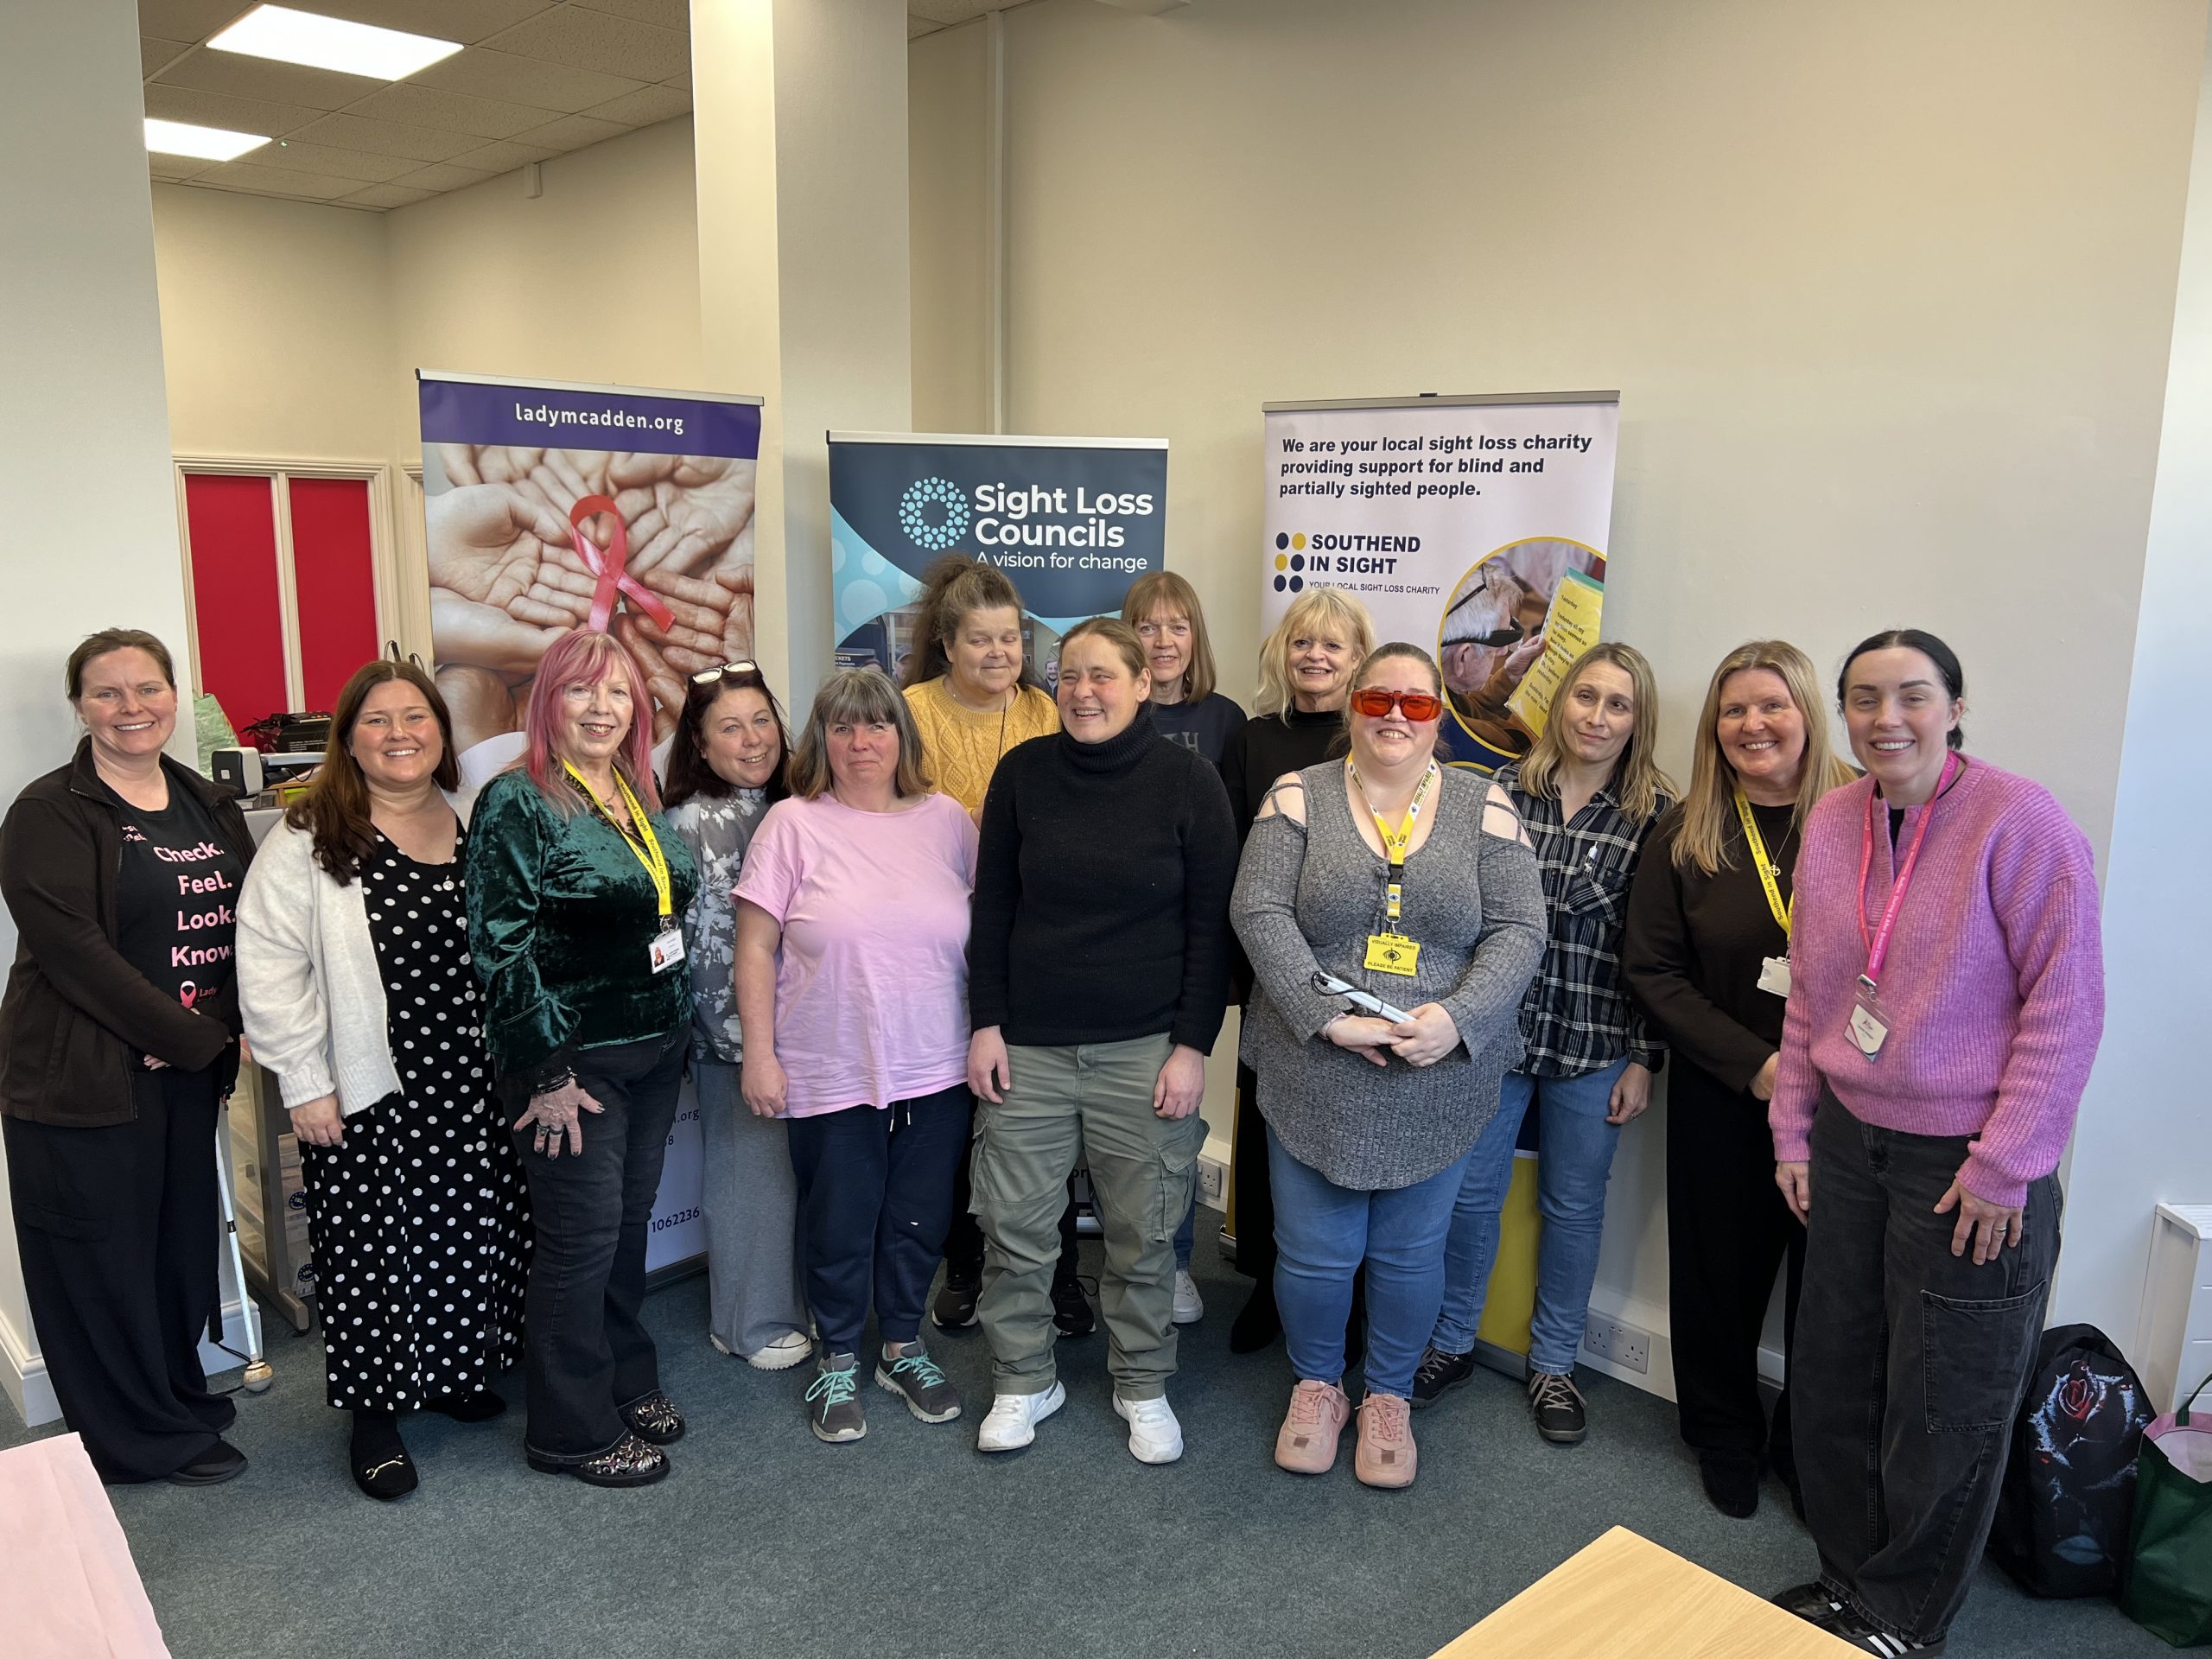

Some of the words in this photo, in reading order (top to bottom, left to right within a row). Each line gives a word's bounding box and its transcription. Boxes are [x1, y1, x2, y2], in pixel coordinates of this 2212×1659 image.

[516, 403, 683, 435] ladymcadden.org
[1282, 439, 1304, 453] We
[1309, 441, 1336, 452] are
[1340, 440, 1378, 455] your
[1382, 436, 1424, 451] local
[1428, 435, 1473, 454] sight
[1478, 435, 1517, 450] loss
[1522, 434, 1592, 453] charity
[1281, 460, 1353, 477] providing
[1358, 459, 1424, 476] support
[1428, 458, 1453, 474] for
[1458, 458, 1503, 473] blind
[1509, 458, 1545, 474] and
[1279, 481, 1345, 499] partially
[1350, 481, 1412, 499] sighted
[1416, 480, 1481, 499] people.
[975, 482, 1068, 520] Sight
[1077, 486, 1154, 516] Loss
[975, 518, 1125, 548] Councils
[1311, 534, 1421, 553] SOUTHEND
[976, 551, 989, 566] A
[993, 550, 1045, 568] vision
[1050, 552, 1075, 569] for
[1079, 553, 1148, 574] change
[1309, 556, 1330, 572] IN
[1336, 557, 1397, 575] SIGHT
[1360, 583, 1382, 592] SIGHT
[1384, 585, 1404, 594] LOSS
[1406, 586, 1440, 595] CHARITY
[153, 842, 225, 862] Check.
[177, 870, 233, 895] Feel.
[177, 905, 236, 931] Look.
[652, 1206, 700, 1233] 1062236
